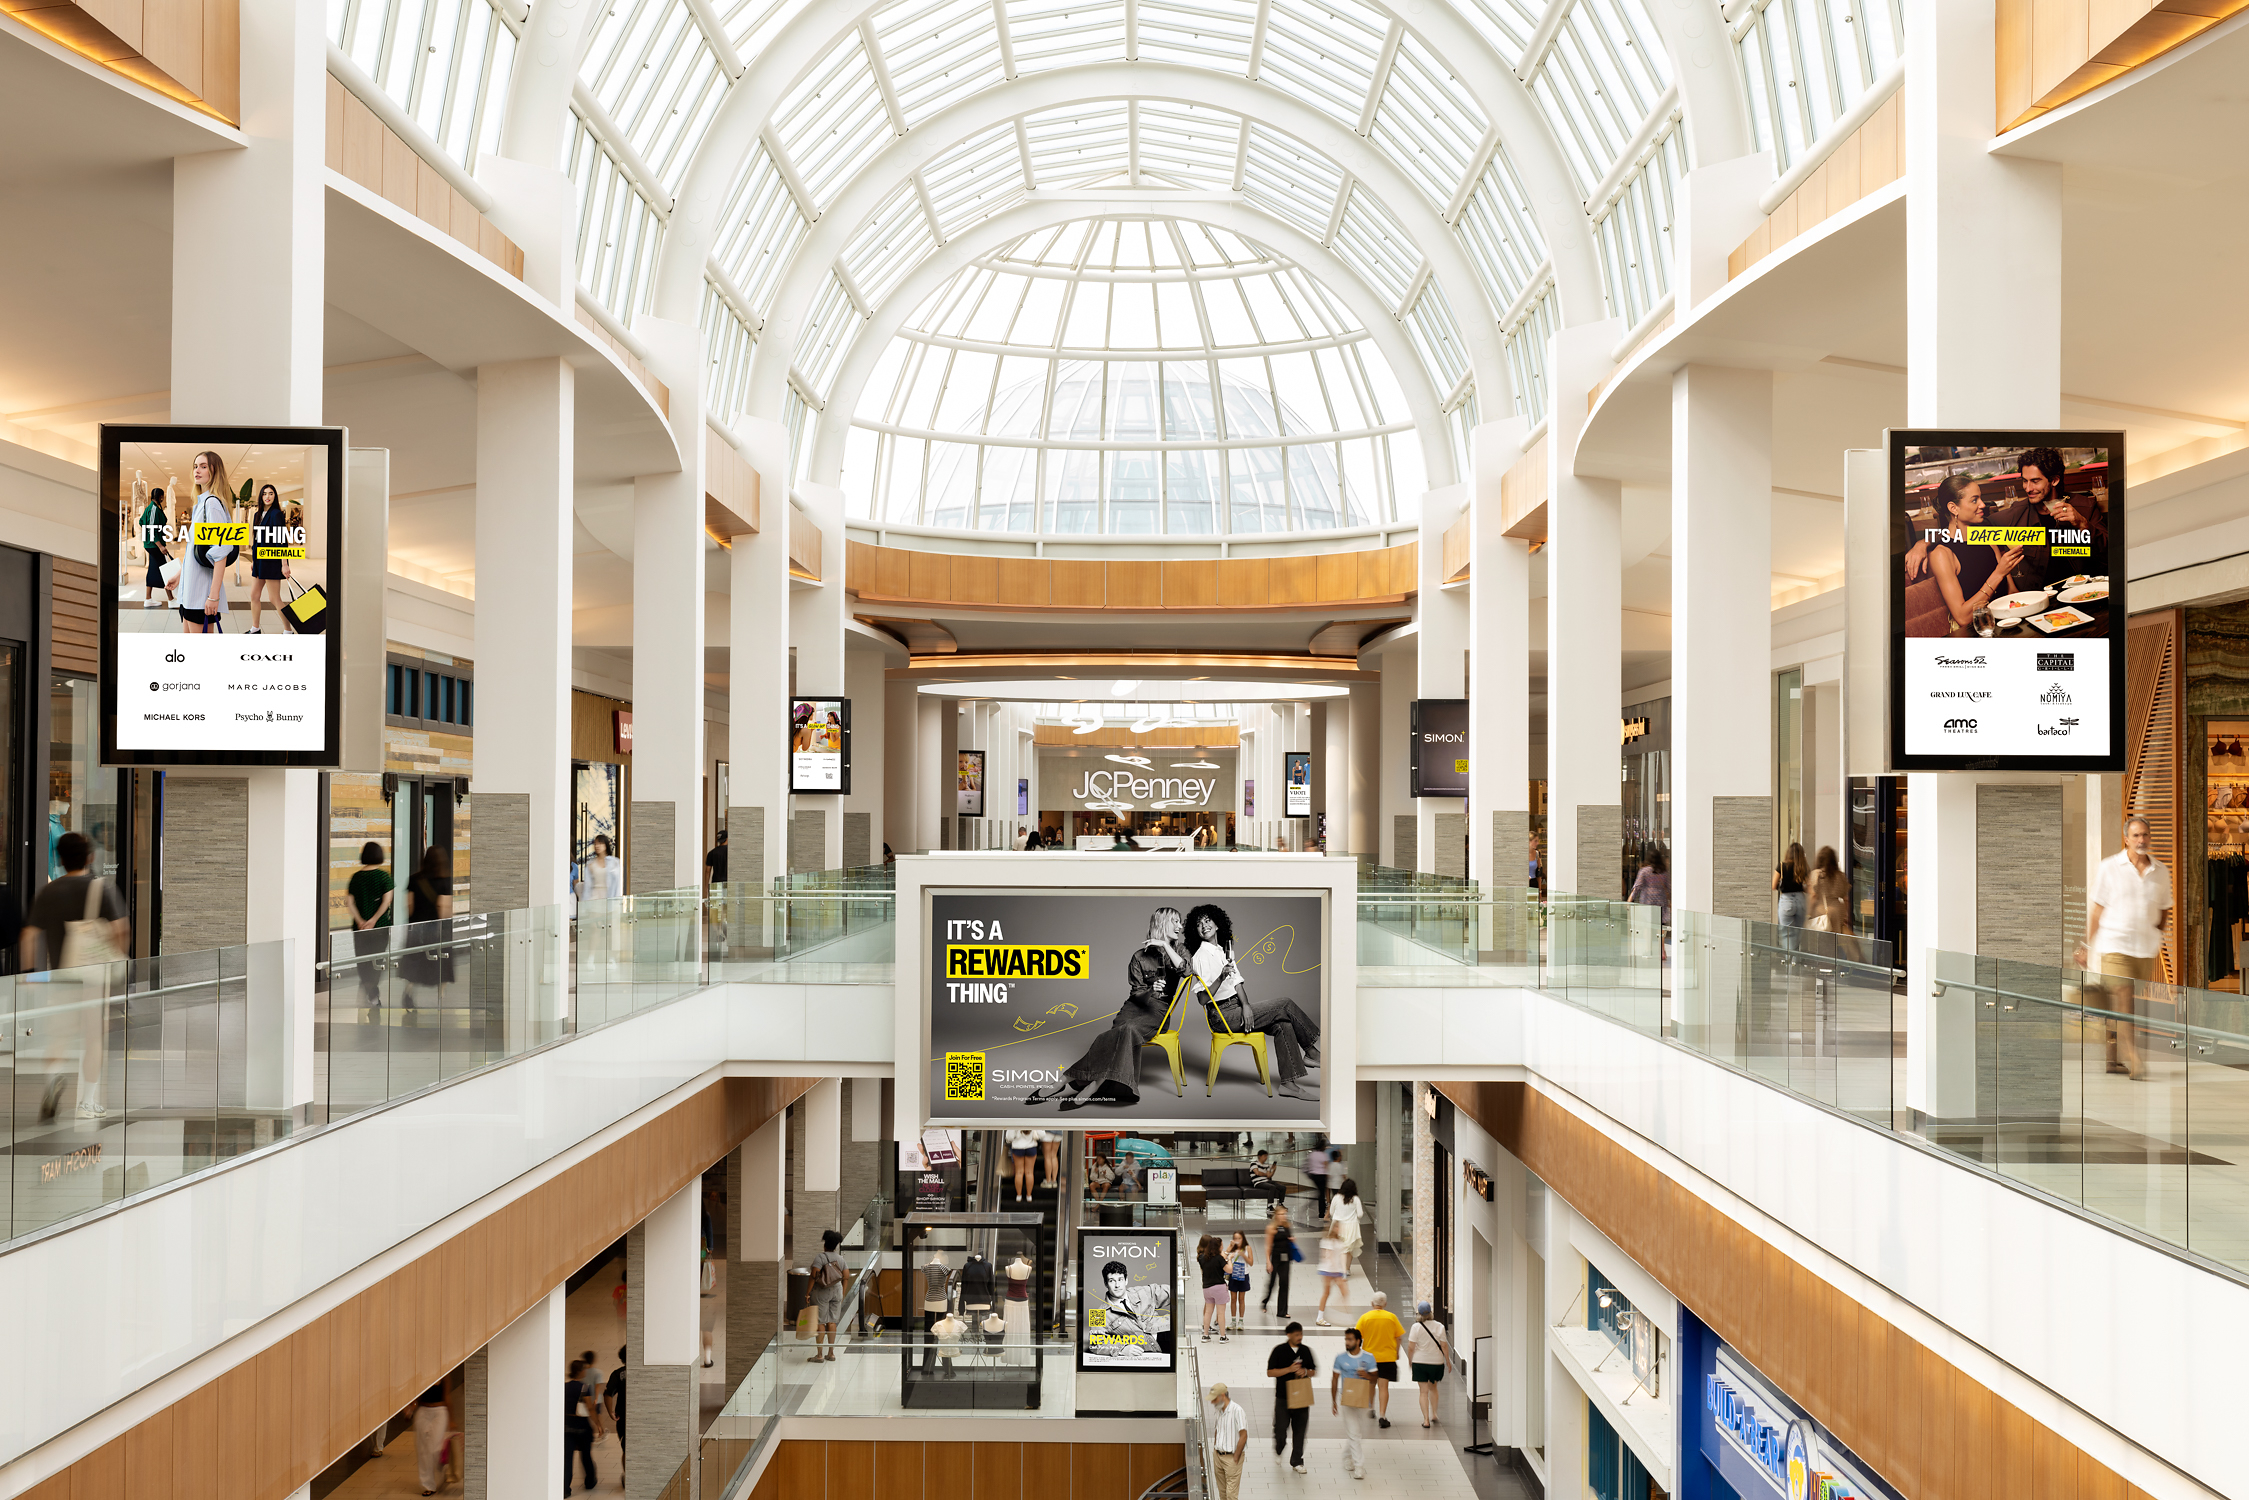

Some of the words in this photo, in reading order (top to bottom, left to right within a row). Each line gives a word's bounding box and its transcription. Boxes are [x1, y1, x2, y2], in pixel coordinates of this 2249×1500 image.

[142, 524, 174, 542] IT'S
[178, 525, 190, 542] A
[197, 526, 246, 546] STYLE
[254, 526, 306, 544] THING
[1924, 528, 1950, 542] IT'S
[1954, 529, 1964, 542] A
[1970, 530, 2002, 542] DATE
[2004, 530, 2044, 542] NIGHT
[2049, 529, 2091, 544] THING
[165, 649, 185, 662] alo
[1934, 656, 1973, 665] Seasons
[1974, 656, 1987, 664] 52
[162, 682, 200, 691] gorjana
[235, 713, 264, 722] Psycho
[276, 713, 303, 722] Bunny
[2038, 724, 2068, 735] bartaco
[1072, 770, 1216, 806] JCPenney
[947, 920, 984, 940] IT'S
[988, 920, 1003, 940] A
[1152, 1170, 1174, 1181] play
[1090, 1334, 1147, 1345] REWARDS.
[1707, 1374, 1781, 1478] BUILD-A-BEAR
